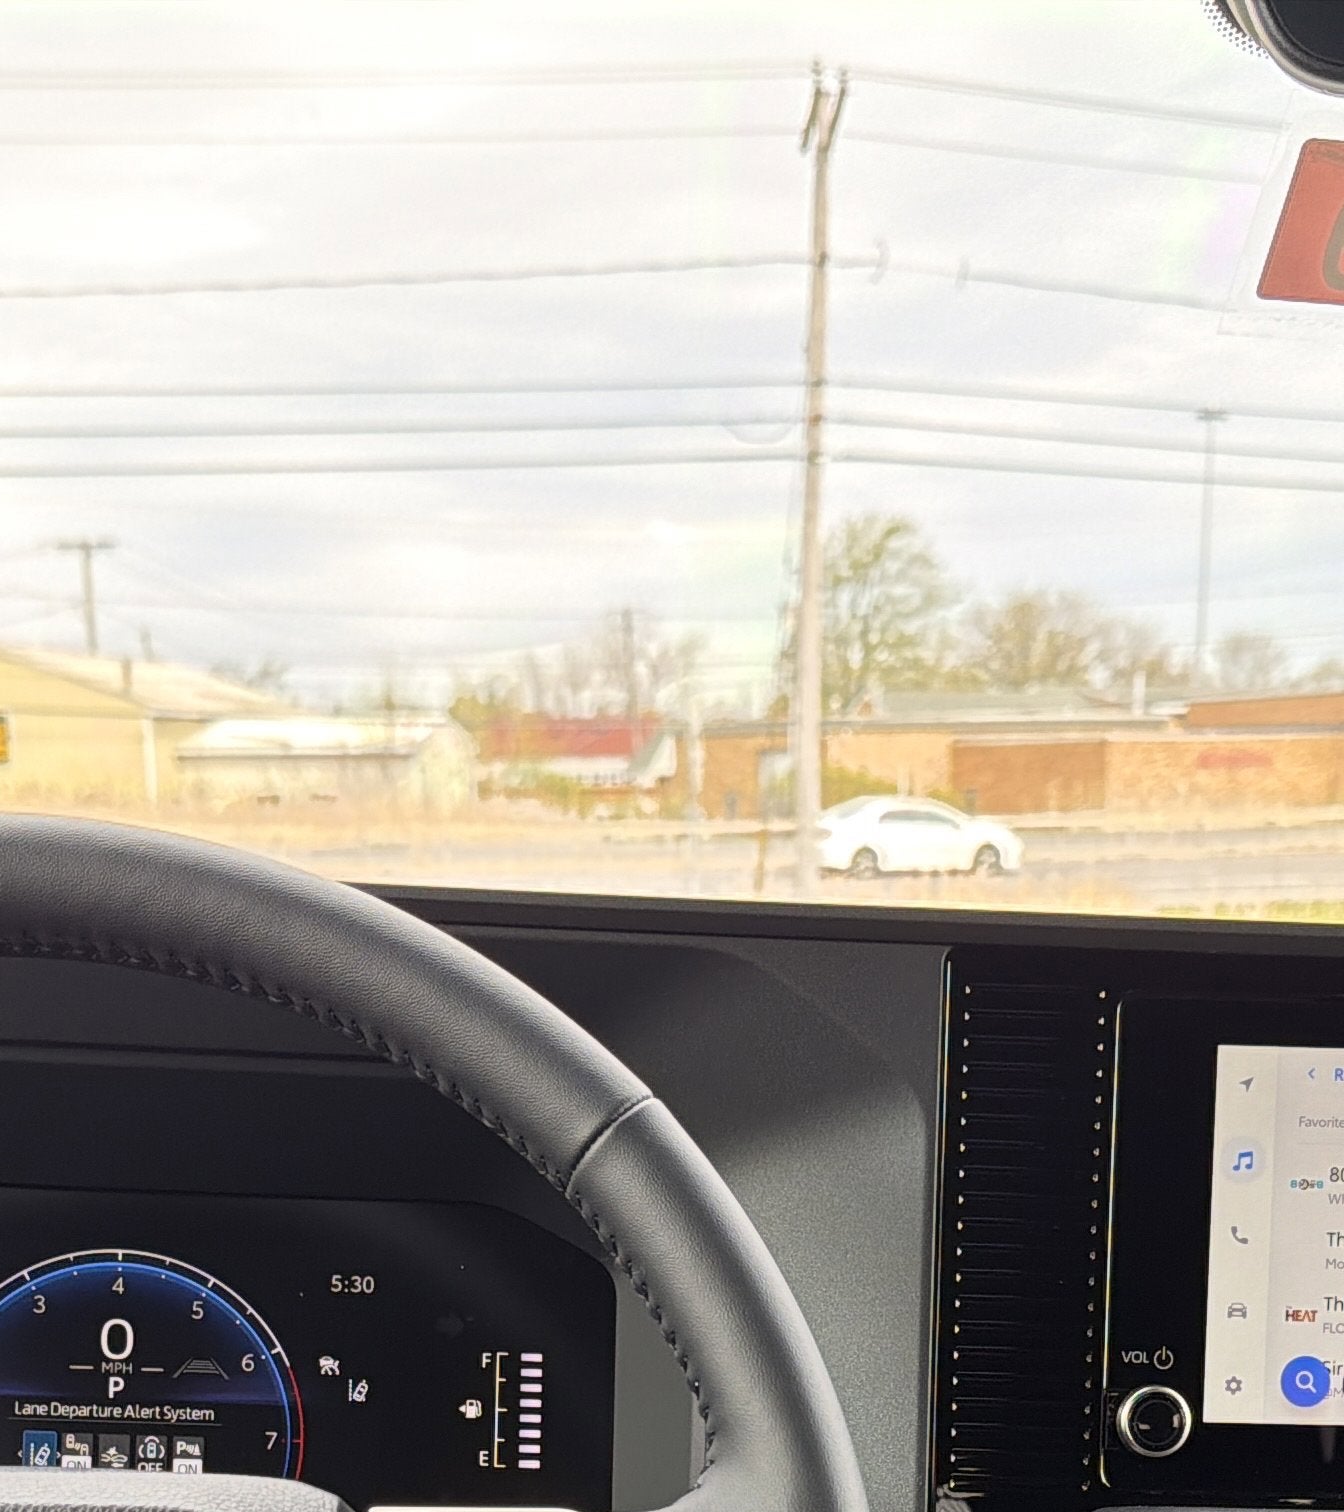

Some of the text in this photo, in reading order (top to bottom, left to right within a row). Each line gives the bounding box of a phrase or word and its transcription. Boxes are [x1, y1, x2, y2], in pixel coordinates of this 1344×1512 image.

[112, 1277, 125, 1295] 4
[330, 1274, 375, 1295] 5:30
[32, 1295, 46, 1314] 3
[191, 1301, 204, 1320] 5
[1285, 1310, 1318, 1323] HEAT
[241, 1353, 255, 1372] 6
[482, 1353, 492, 1369] F
[1121, 1351, 1149, 1363] VOL
[101, 1362, 132, 1375] MPH
[108, 1377, 125, 1399] P
[14, 1400, 215, 1423] Lane Departure Alert System
[265, 1431, 278, 1450] 7
[479, 1451, 489, 1467] E
[178, 1463, 197, 1474] ON
